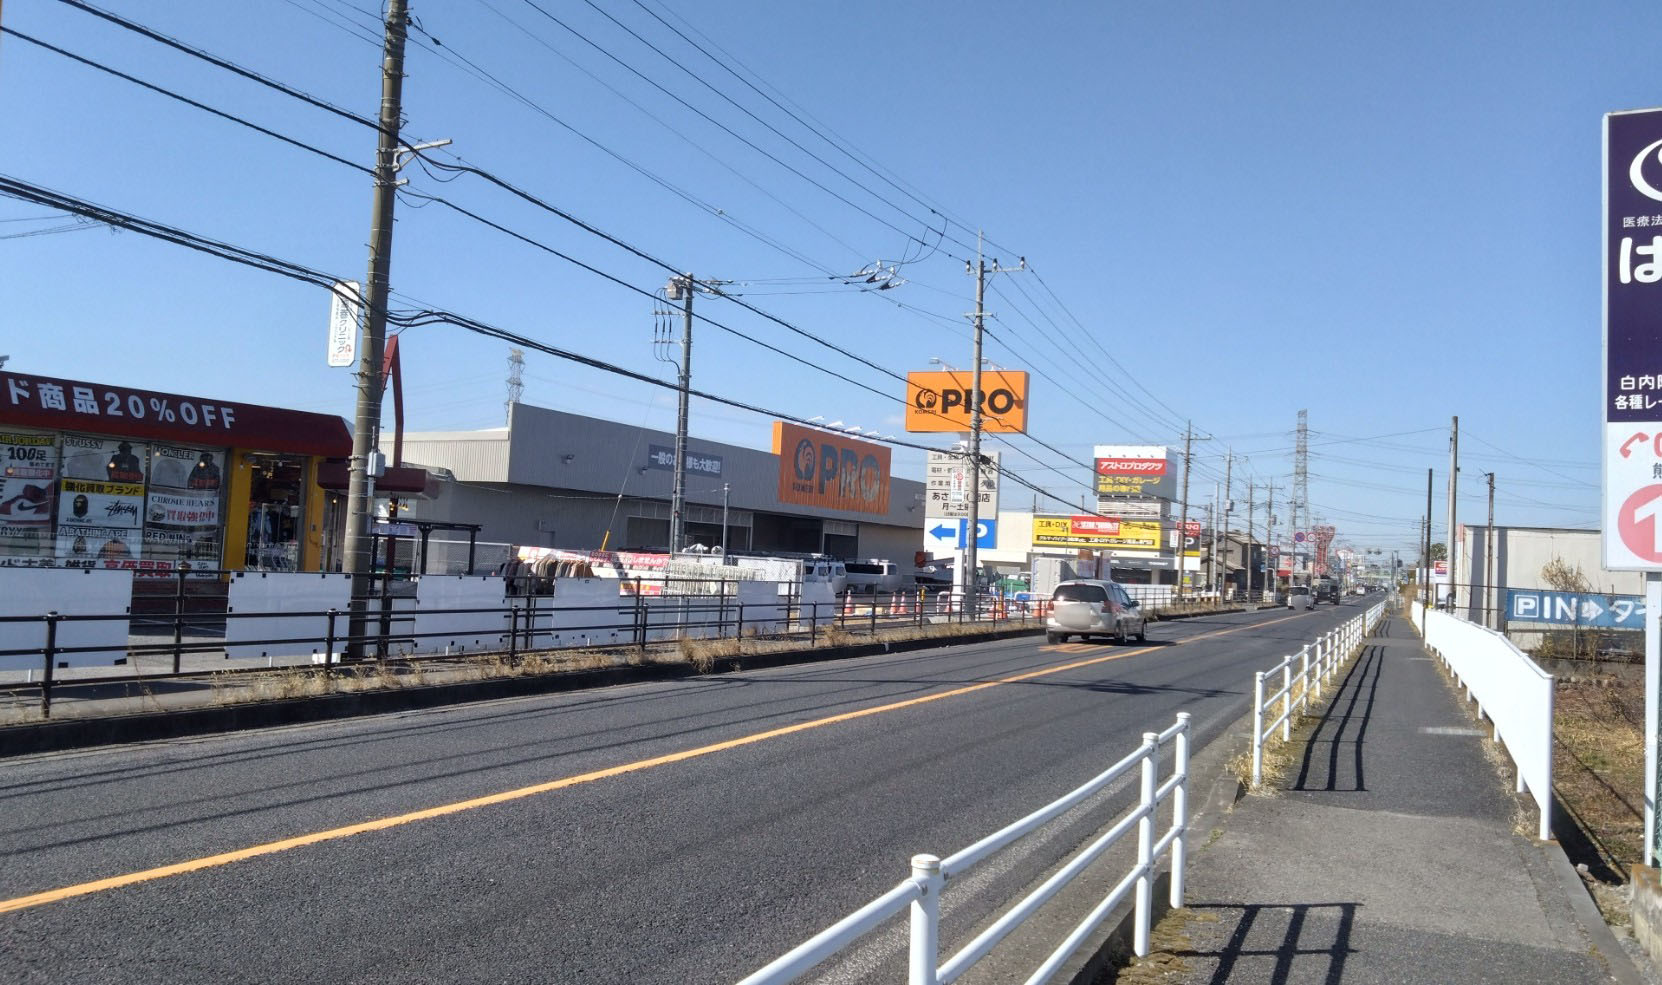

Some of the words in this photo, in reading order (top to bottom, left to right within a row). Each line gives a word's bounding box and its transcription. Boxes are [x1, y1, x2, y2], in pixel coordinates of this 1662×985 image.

[7, 378, 236, 429] ド商品20%OFF
[941, 388, 1014, 414] PRO
[820, 444, 881, 502] PRO
[1185, 537, 1195, 548] P
